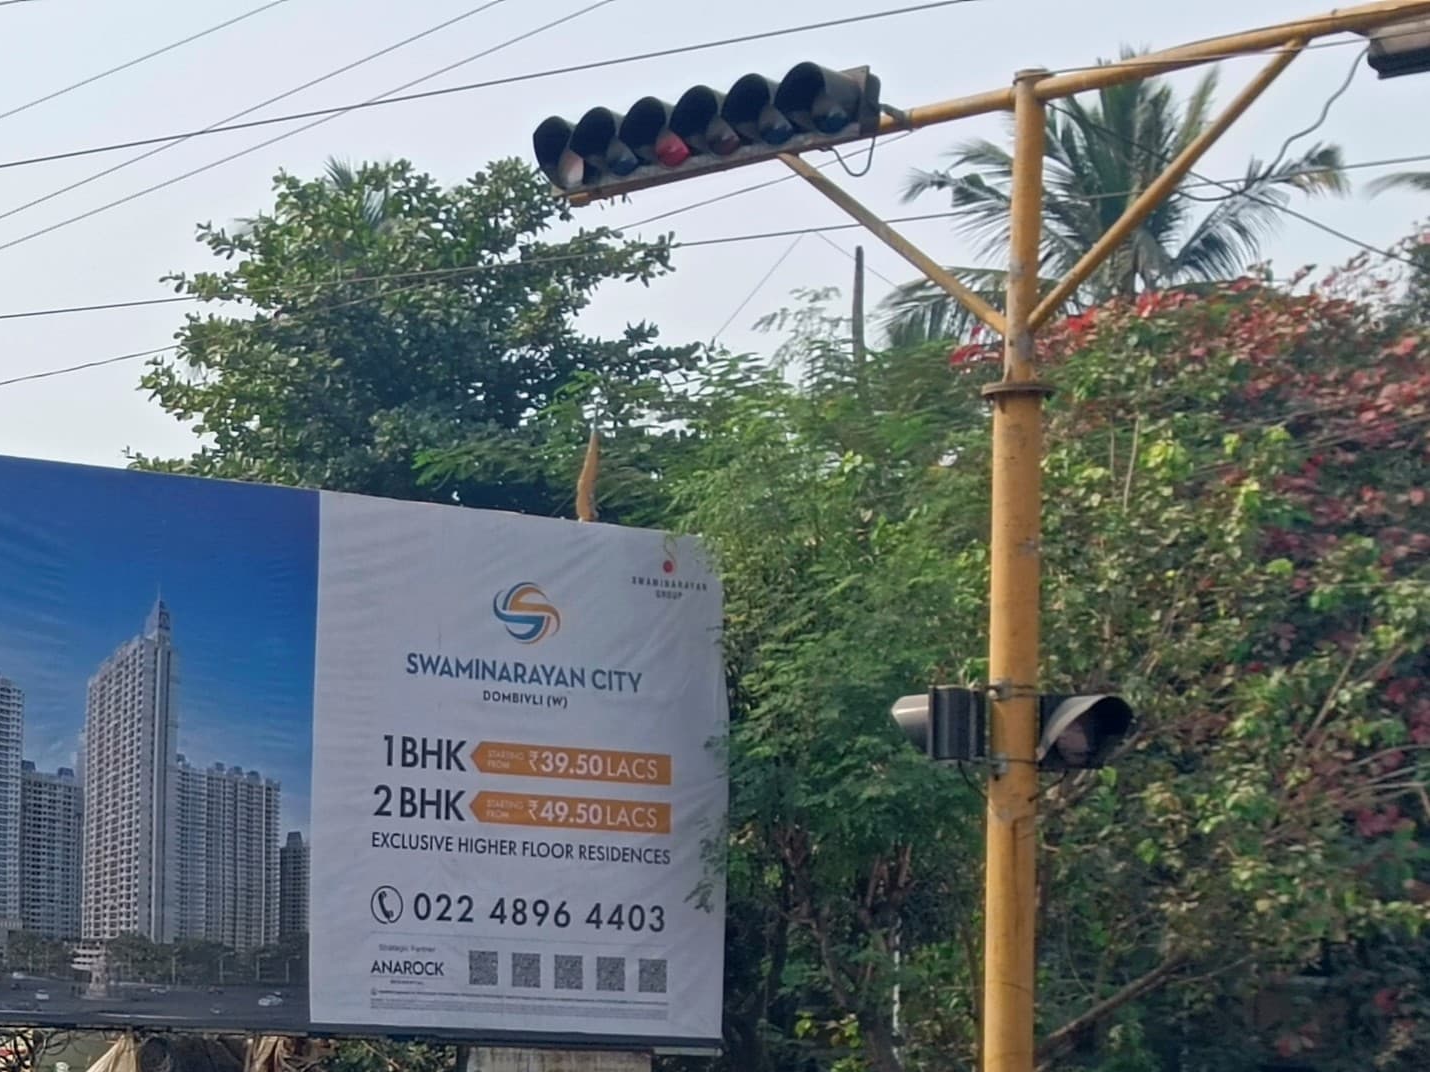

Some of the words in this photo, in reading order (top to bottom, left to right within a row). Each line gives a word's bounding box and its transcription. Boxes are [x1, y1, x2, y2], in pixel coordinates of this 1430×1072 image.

[632, 576, 708, 591] SWAMINARAYAN
[656, 590, 683, 601] GROUP
[406, 652, 586, 691] SWAMINARAYAN
[591, 668, 642, 694] CITY
[483, 690, 544, 706] DOMBIVLI
[546, 694, 568, 709] (W)
[384, 734, 394, 767] 1
[401, 736, 467, 772] BHK
[606, 758, 658, 780] LACS
[373, 784, 393, 818] 2
[400, 786, 466, 821] BHK
[606, 807, 658, 829] LACS
[372, 832, 453, 852] EXCLUSIVE
[458, 837, 517, 857] HIGHER
[522, 841, 574, 860] FLOOR
[579, 845, 671, 865] RESIDENCES
[414, 893, 474, 924] 022
[489, 897, 571, 928] 4896
[585, 901, 666, 933] 4403
[370, 960, 444, 977] ANAROCK
